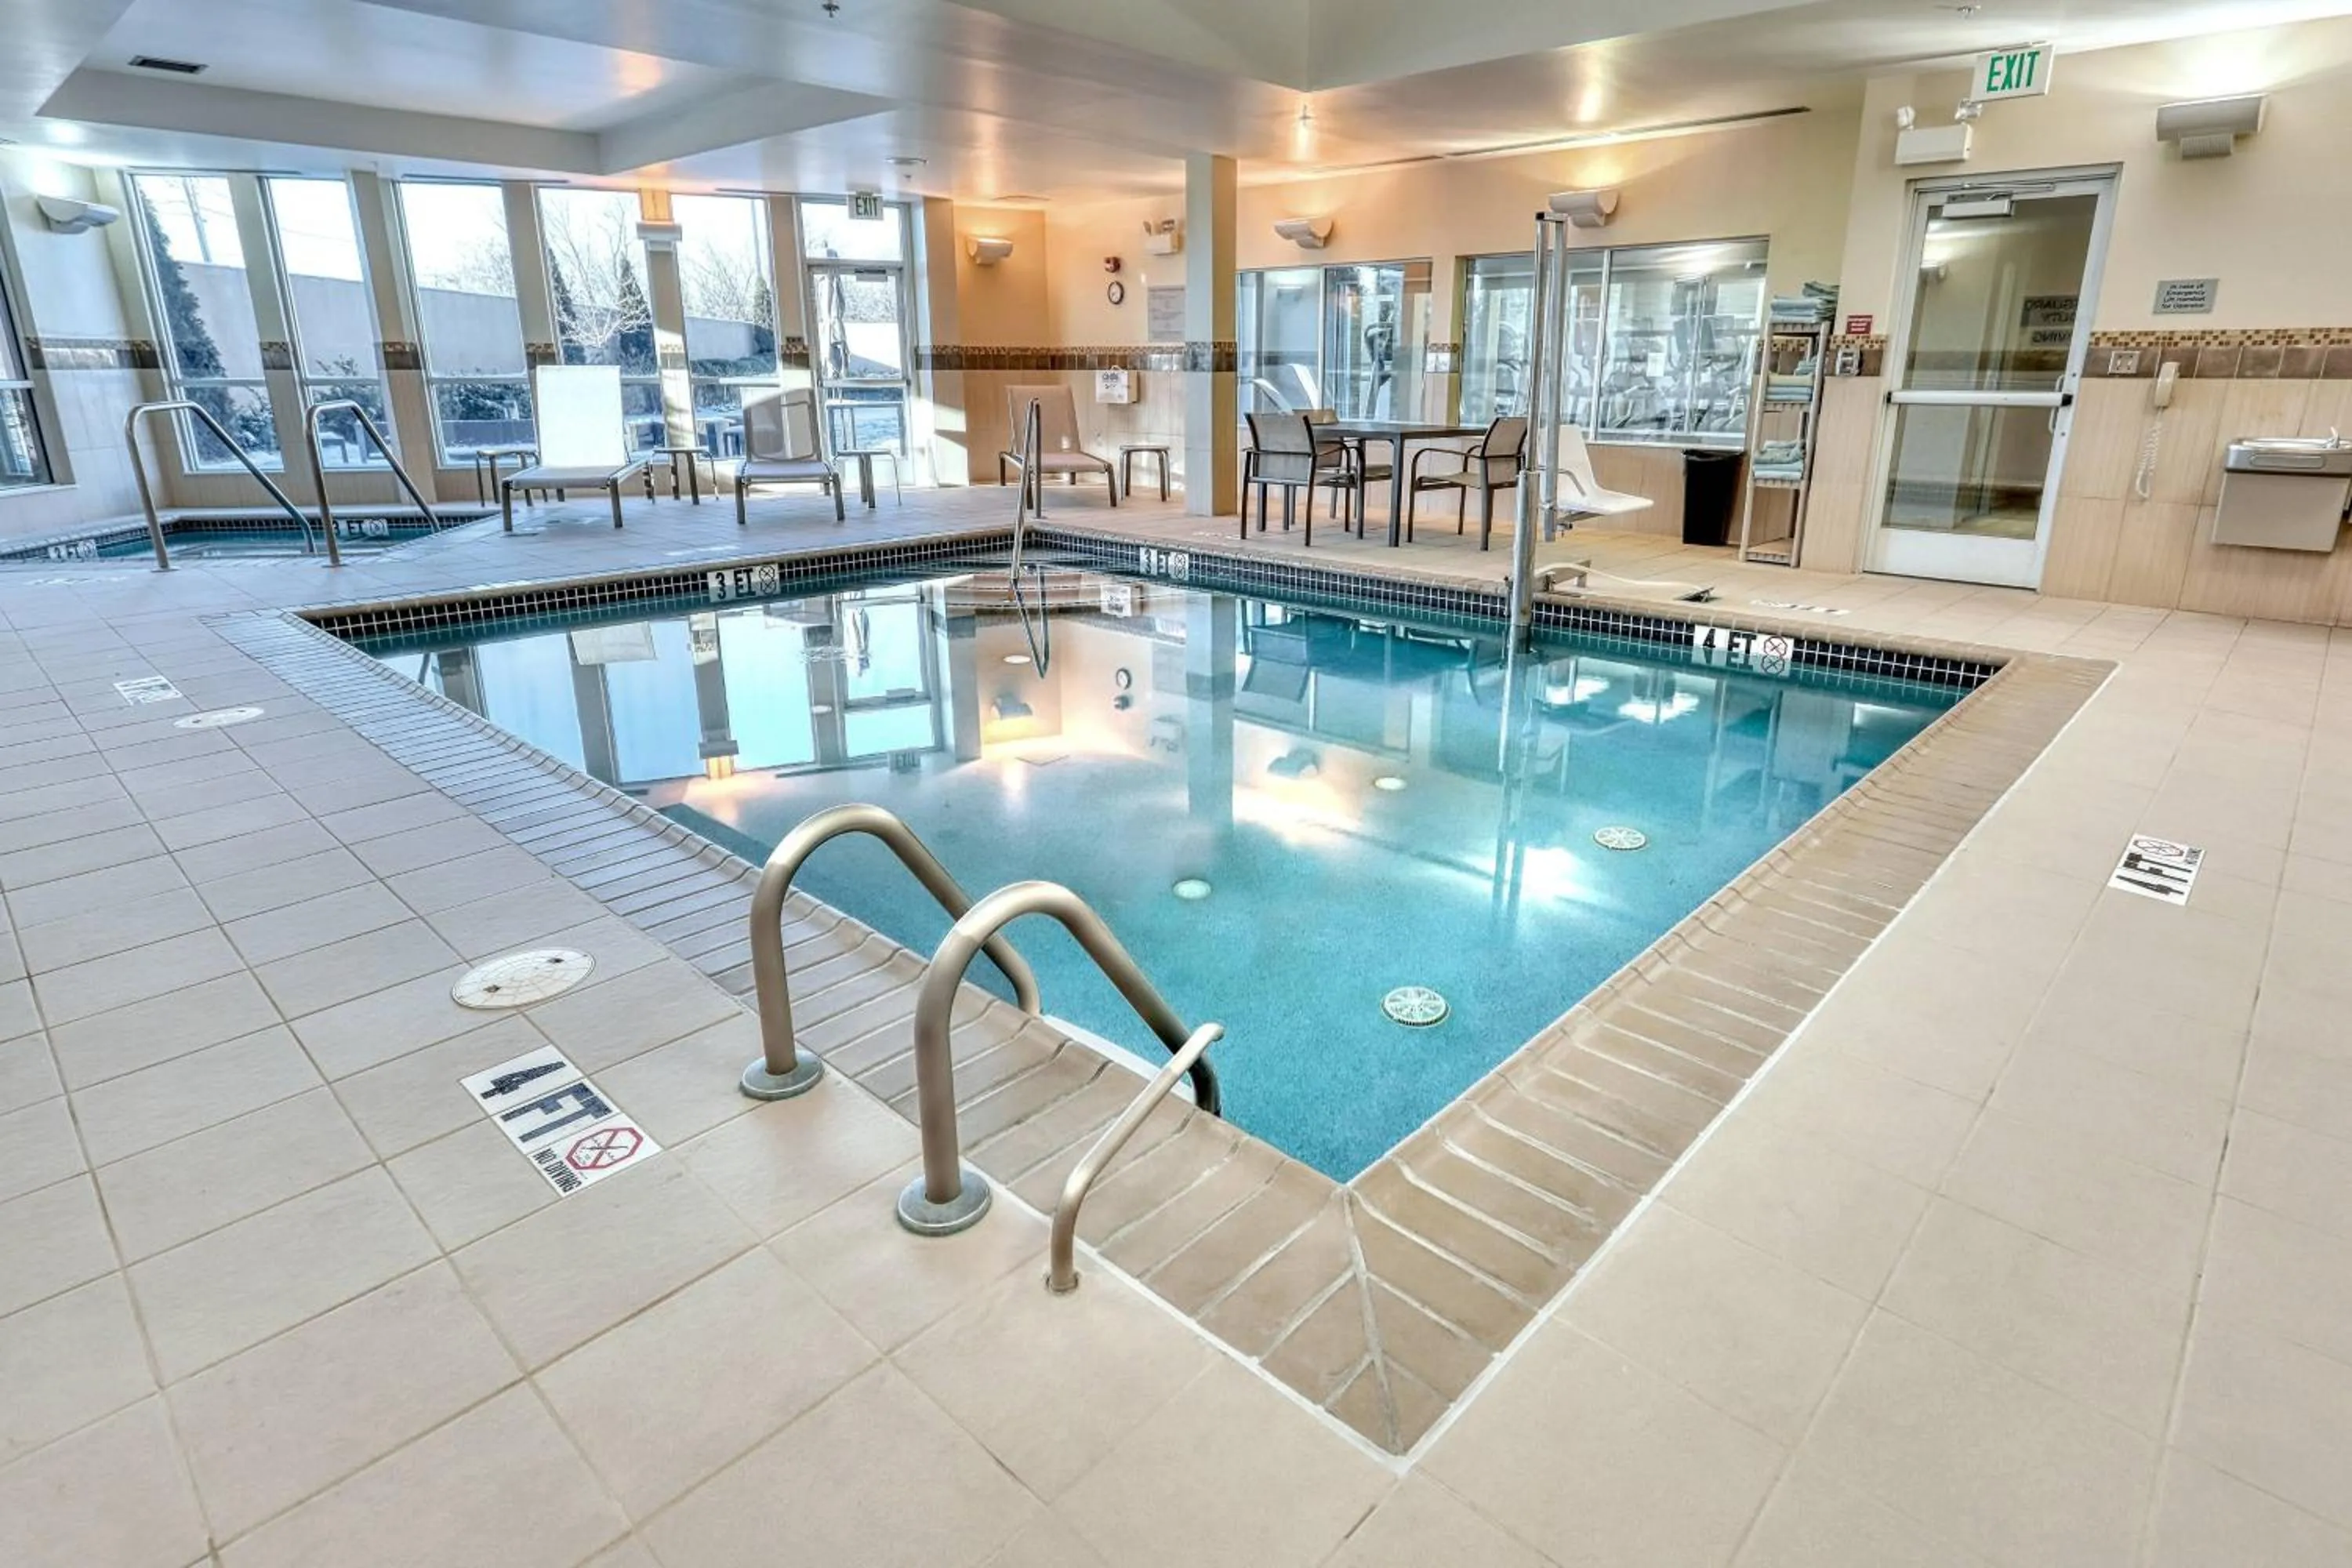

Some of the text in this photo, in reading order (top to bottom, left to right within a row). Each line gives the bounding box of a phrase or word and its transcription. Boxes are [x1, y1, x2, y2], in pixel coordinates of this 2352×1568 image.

[1986, 50, 2040, 93] EXIT
[855, 196, 878, 217] EXIT
[1703, 628, 1757, 654] 4 FT
[480, 1061, 613, 1144] 4 FT
[533, 1148, 583, 1193] NO DIVING
